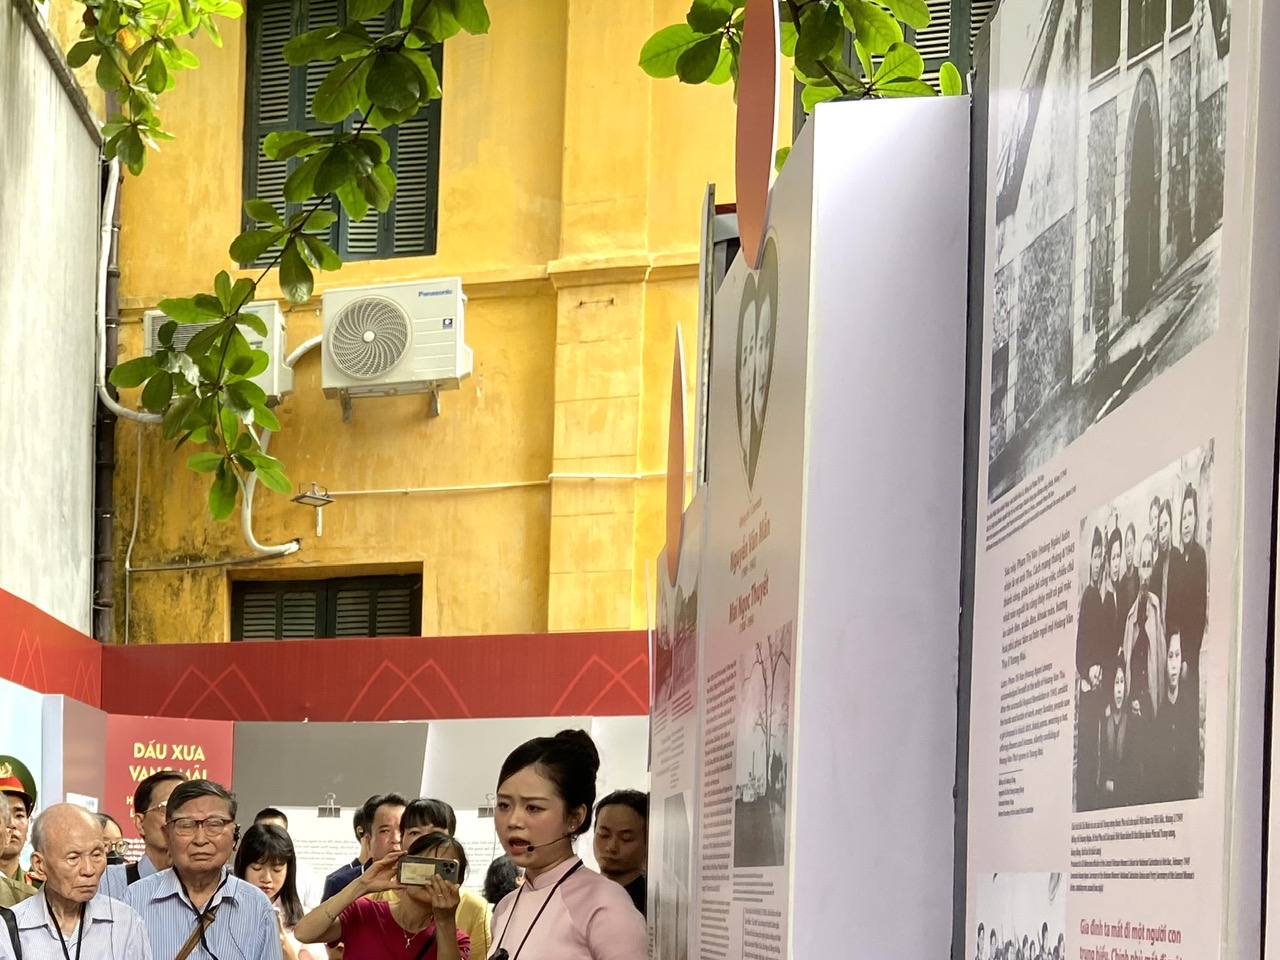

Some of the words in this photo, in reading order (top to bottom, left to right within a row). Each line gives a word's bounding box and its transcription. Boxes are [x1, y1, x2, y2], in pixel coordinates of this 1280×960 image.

[418, 289, 453, 297] Panasonic
[134, 740, 167, 759] DẤU
[171, 744, 206, 762] XƯA
[1080, 920, 1089, 935] Gia
[1090, 921, 1103, 936] đình
[1104, 922, 1110, 937] ta
[1111, 922, 1123, 938] mất
[1124, 923, 1131, 939] đi
[1132, 924, 1145, 944] một
[1146, 926, 1166, 946] người
[1168, 930, 1181, 944] con
